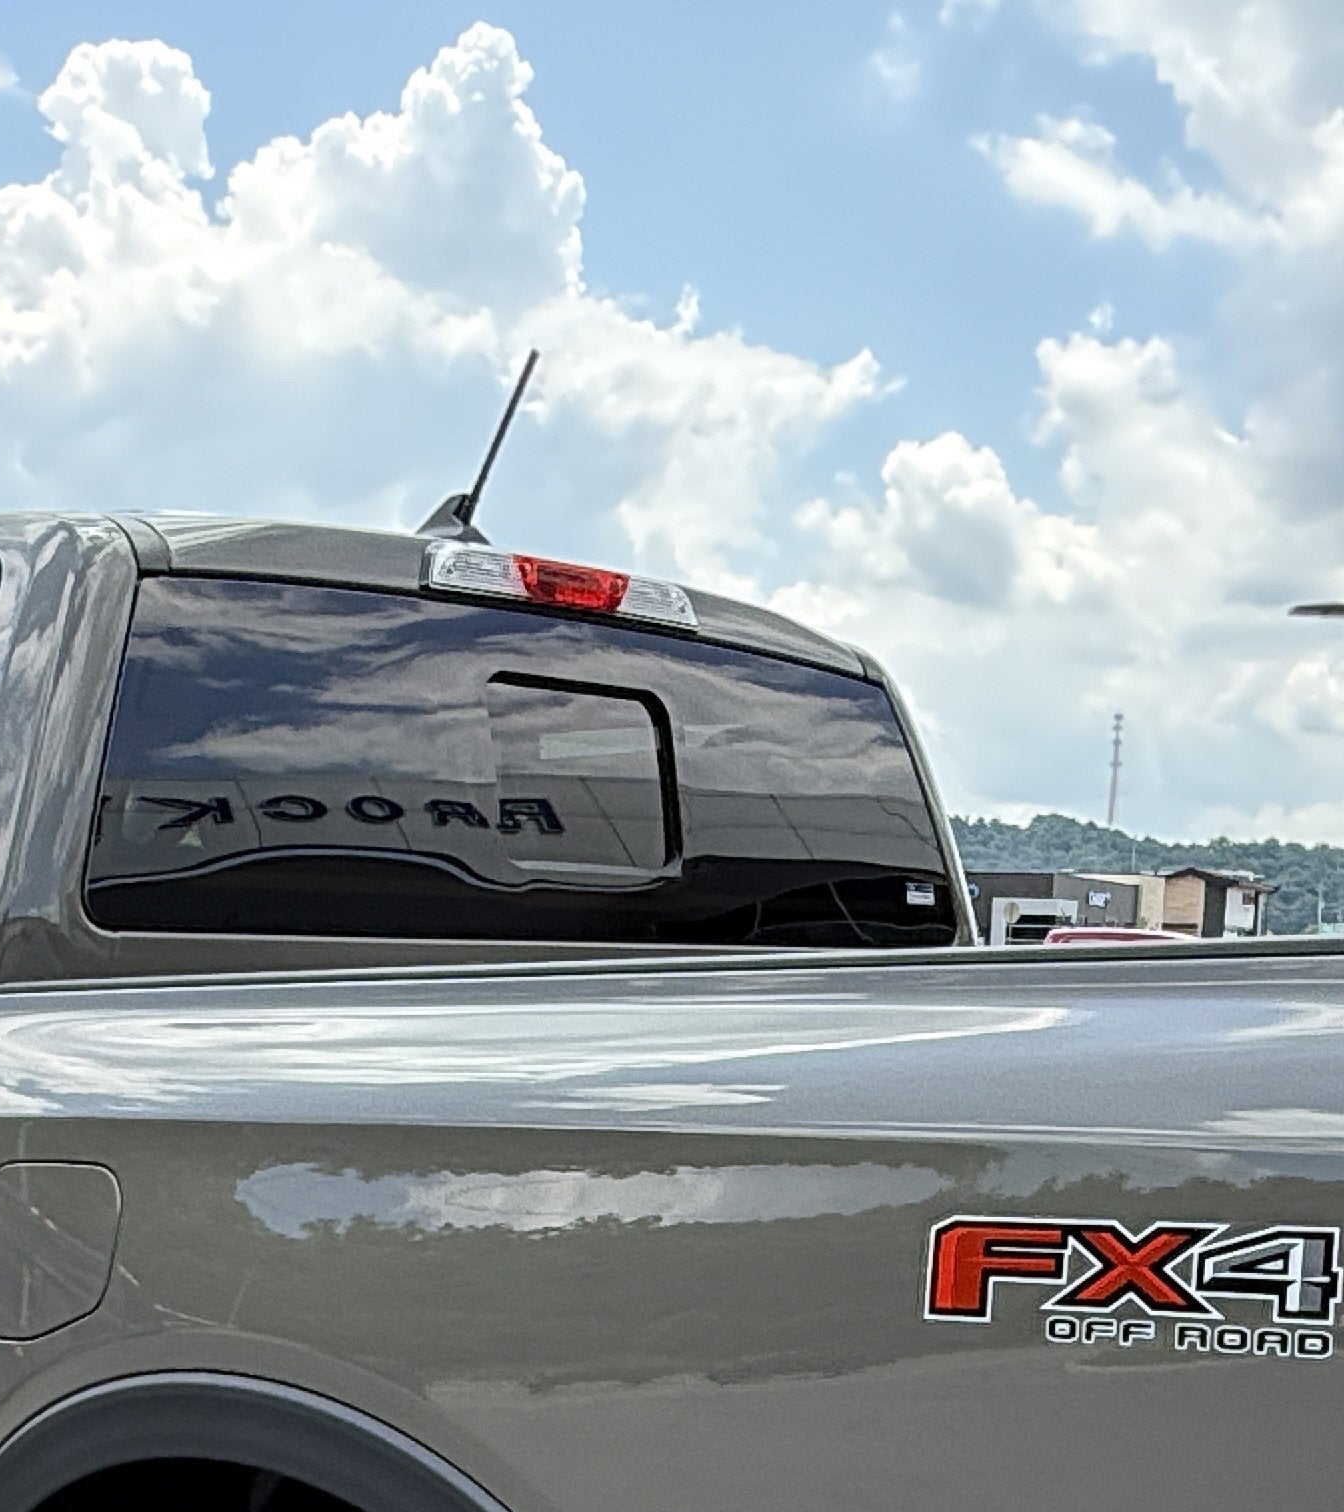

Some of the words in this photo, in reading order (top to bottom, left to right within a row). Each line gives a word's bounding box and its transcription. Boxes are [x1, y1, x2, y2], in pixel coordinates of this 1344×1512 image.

[925, 1215, 1343, 1324] FX4
[1045, 1316, 1154, 1347] OFF
[1174, 1324, 1335, 1360] ROAD
